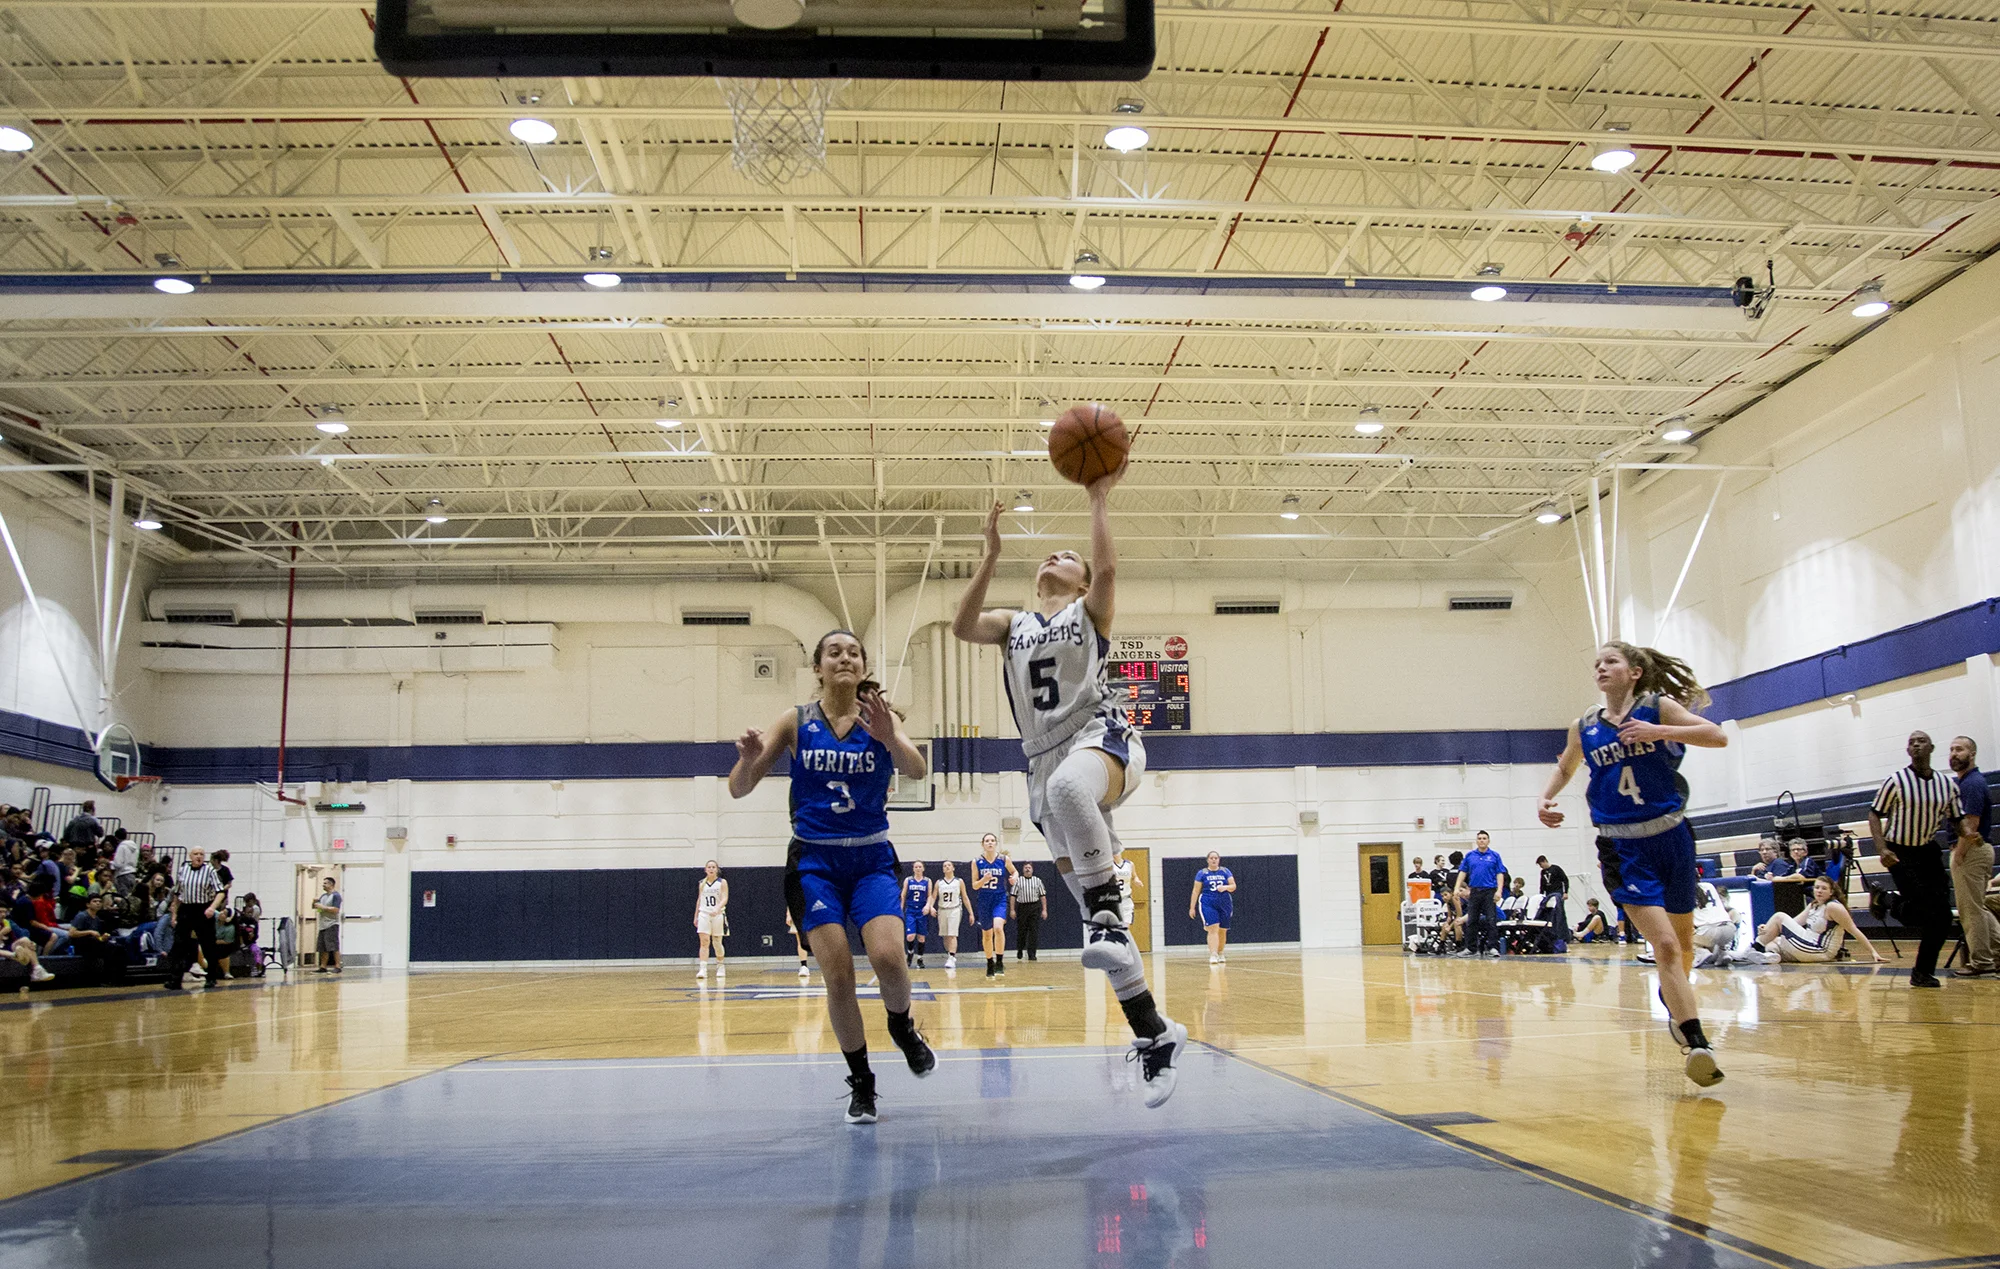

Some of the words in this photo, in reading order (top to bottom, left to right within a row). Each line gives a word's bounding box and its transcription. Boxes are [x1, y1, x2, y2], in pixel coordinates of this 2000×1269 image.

[1120, 641, 1144, 649] TSD
[1119, 662, 1158, 680] 4:01
[1160, 663, 1188, 673] VISITOR
[1028, 656, 1060, 711] 5
[1177, 675, 1189, 693] 9
[1128, 685, 1138, 699] 3
[801, 749, 875, 774] VERITAS
[1618, 765, 1645, 806] 4
[826, 780, 856, 814] 3
[705, 896, 716, 907] 10
[913, 891, 920, 902] 2
[943, 892, 953, 902] 21
